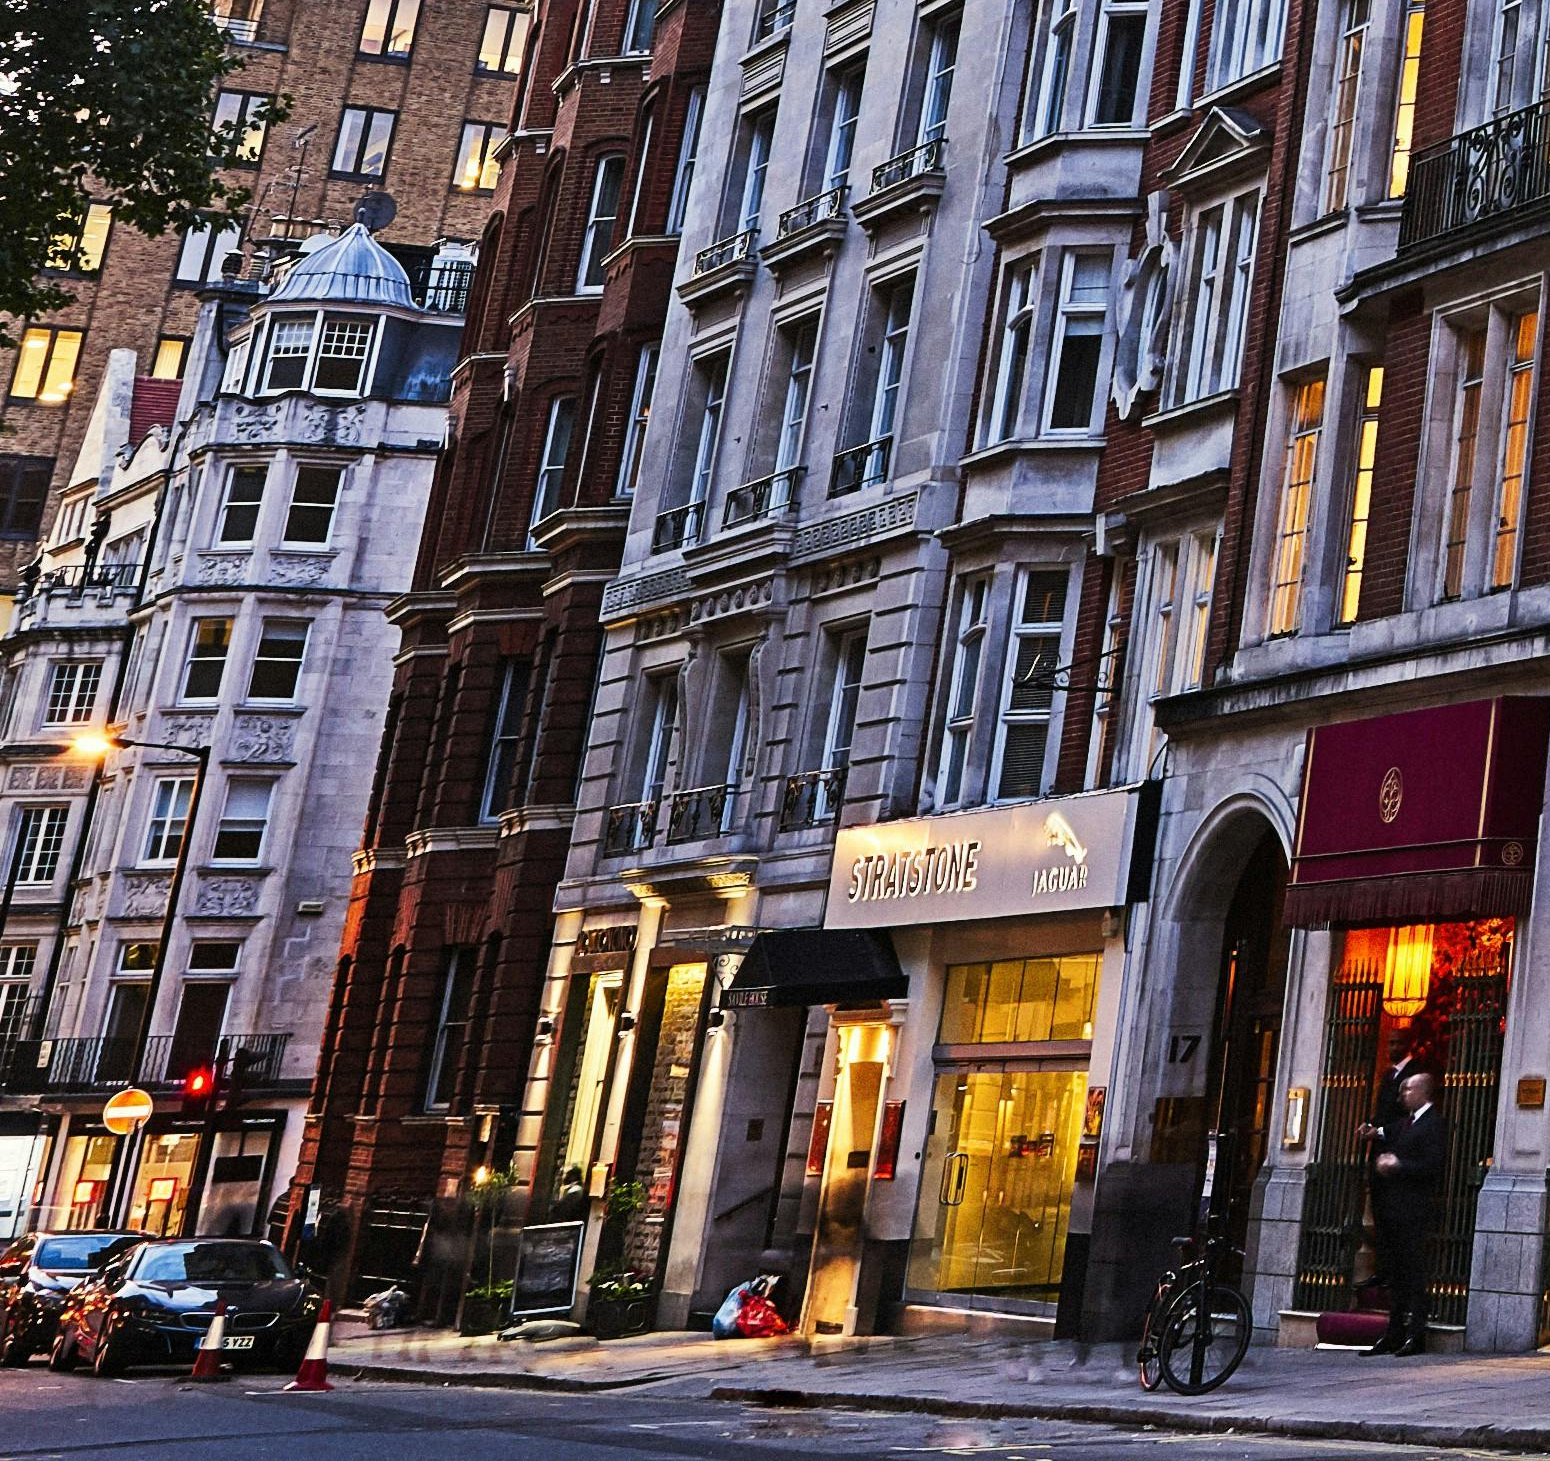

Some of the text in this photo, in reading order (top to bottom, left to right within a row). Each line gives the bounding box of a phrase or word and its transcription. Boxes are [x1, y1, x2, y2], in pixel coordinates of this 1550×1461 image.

[848, 839, 983, 903] STRATSTONE
[1031, 864, 1089, 898] JAGUAR
[1168, 1035, 1202, 1064] 17
[232, 1337, 253, 1348] YZZ
